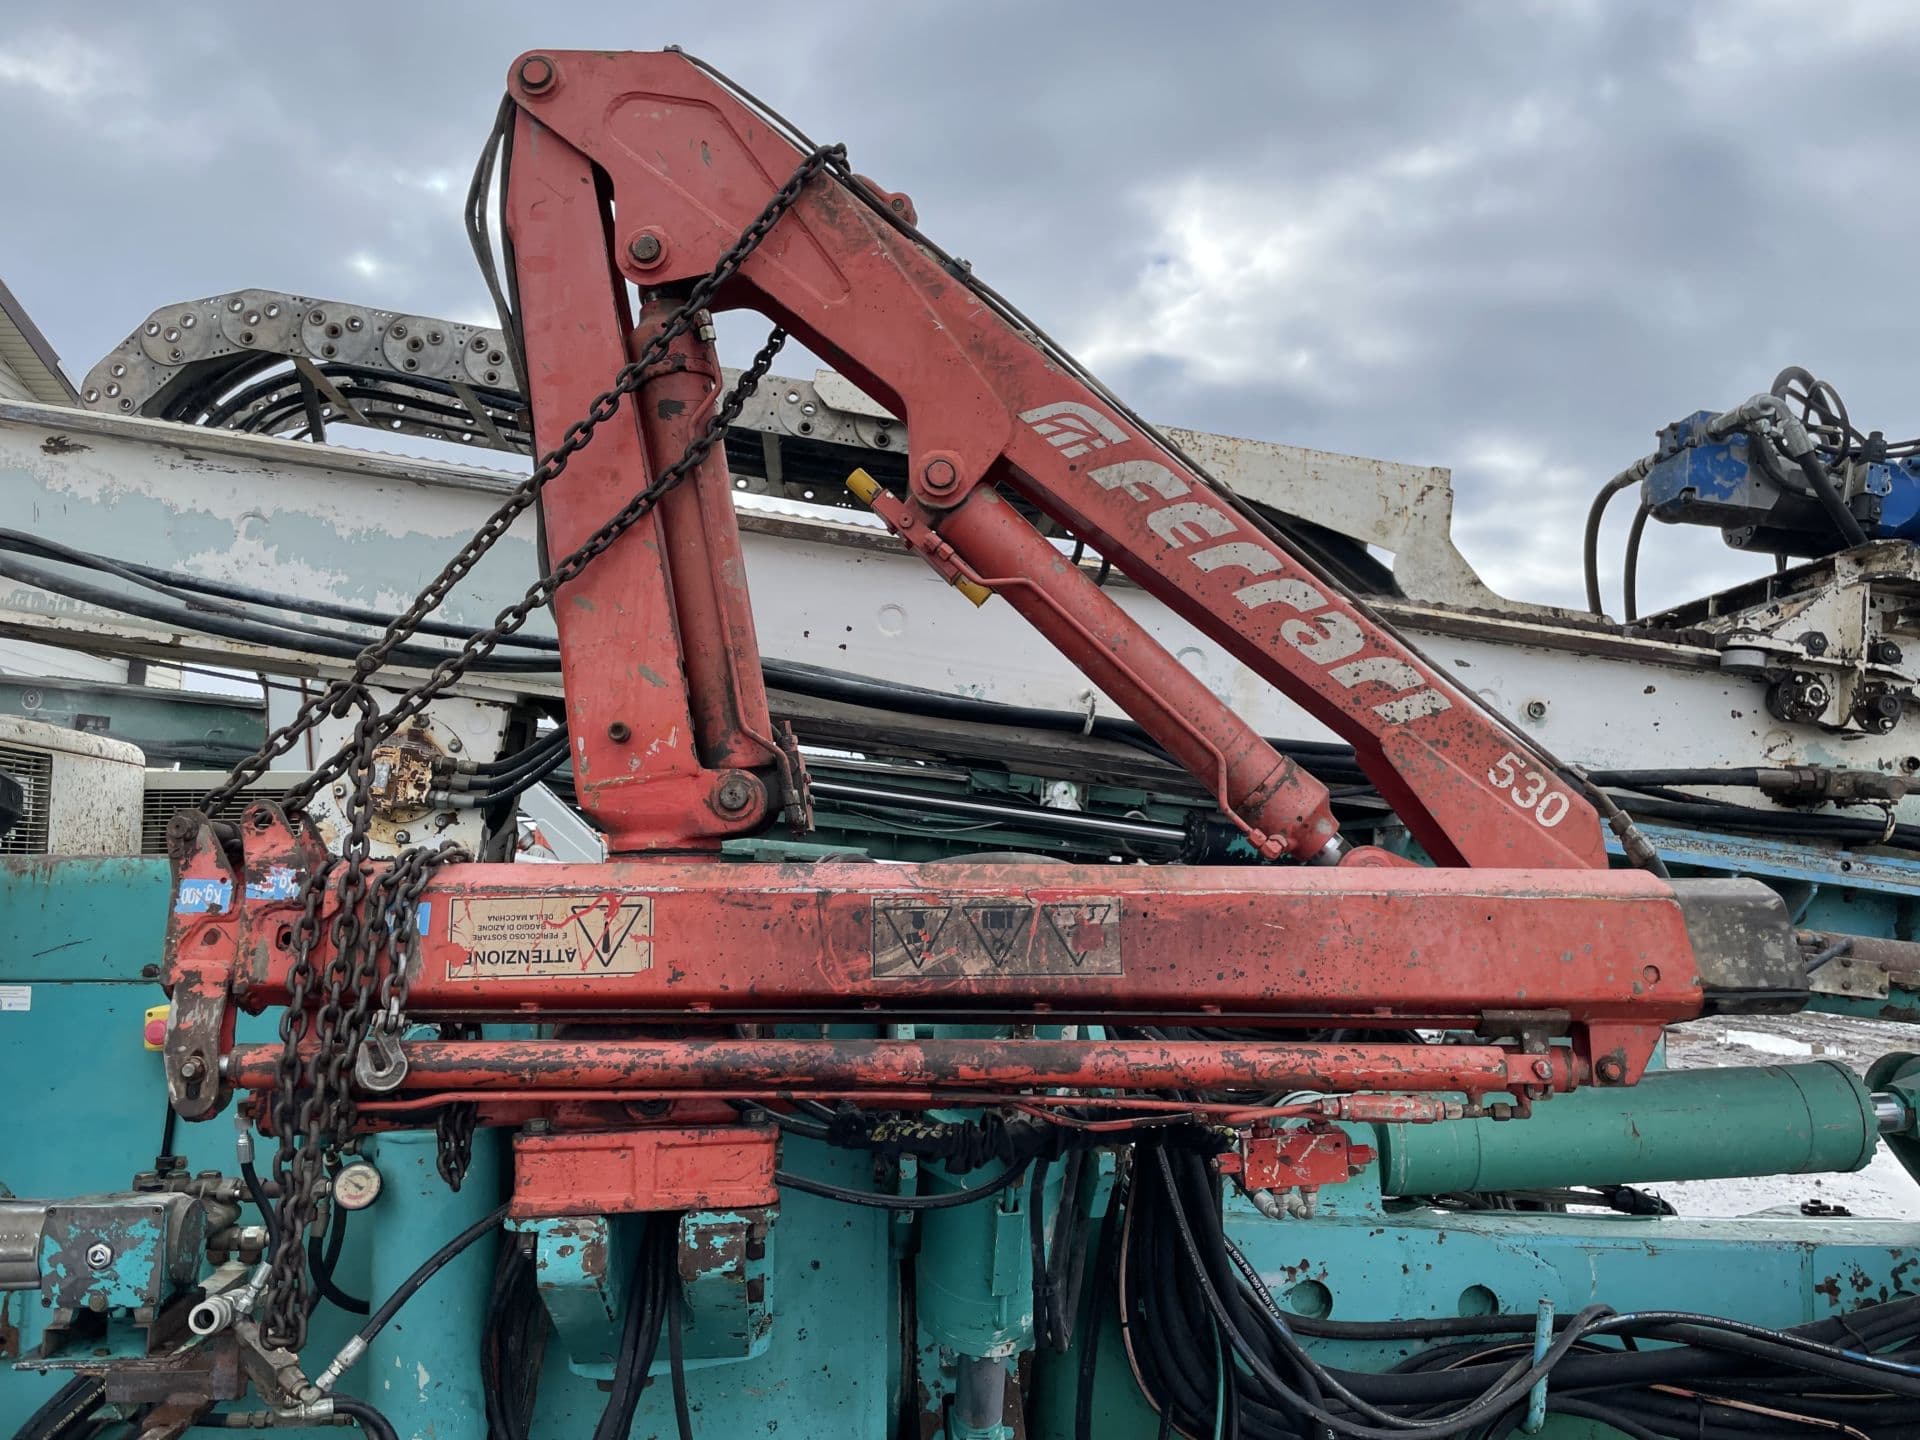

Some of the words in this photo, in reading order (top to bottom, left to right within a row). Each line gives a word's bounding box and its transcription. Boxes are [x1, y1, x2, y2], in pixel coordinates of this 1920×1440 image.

[1487, 752, 1569, 828] 530
[487, 914, 528, 922] MACCHINA
[477, 924, 506, 932] AZIONE
[506, 923, 515, 931] DI
[472, 933, 508, 941] SOSTARE
[509, 931, 559, 940] PERICOLOSO
